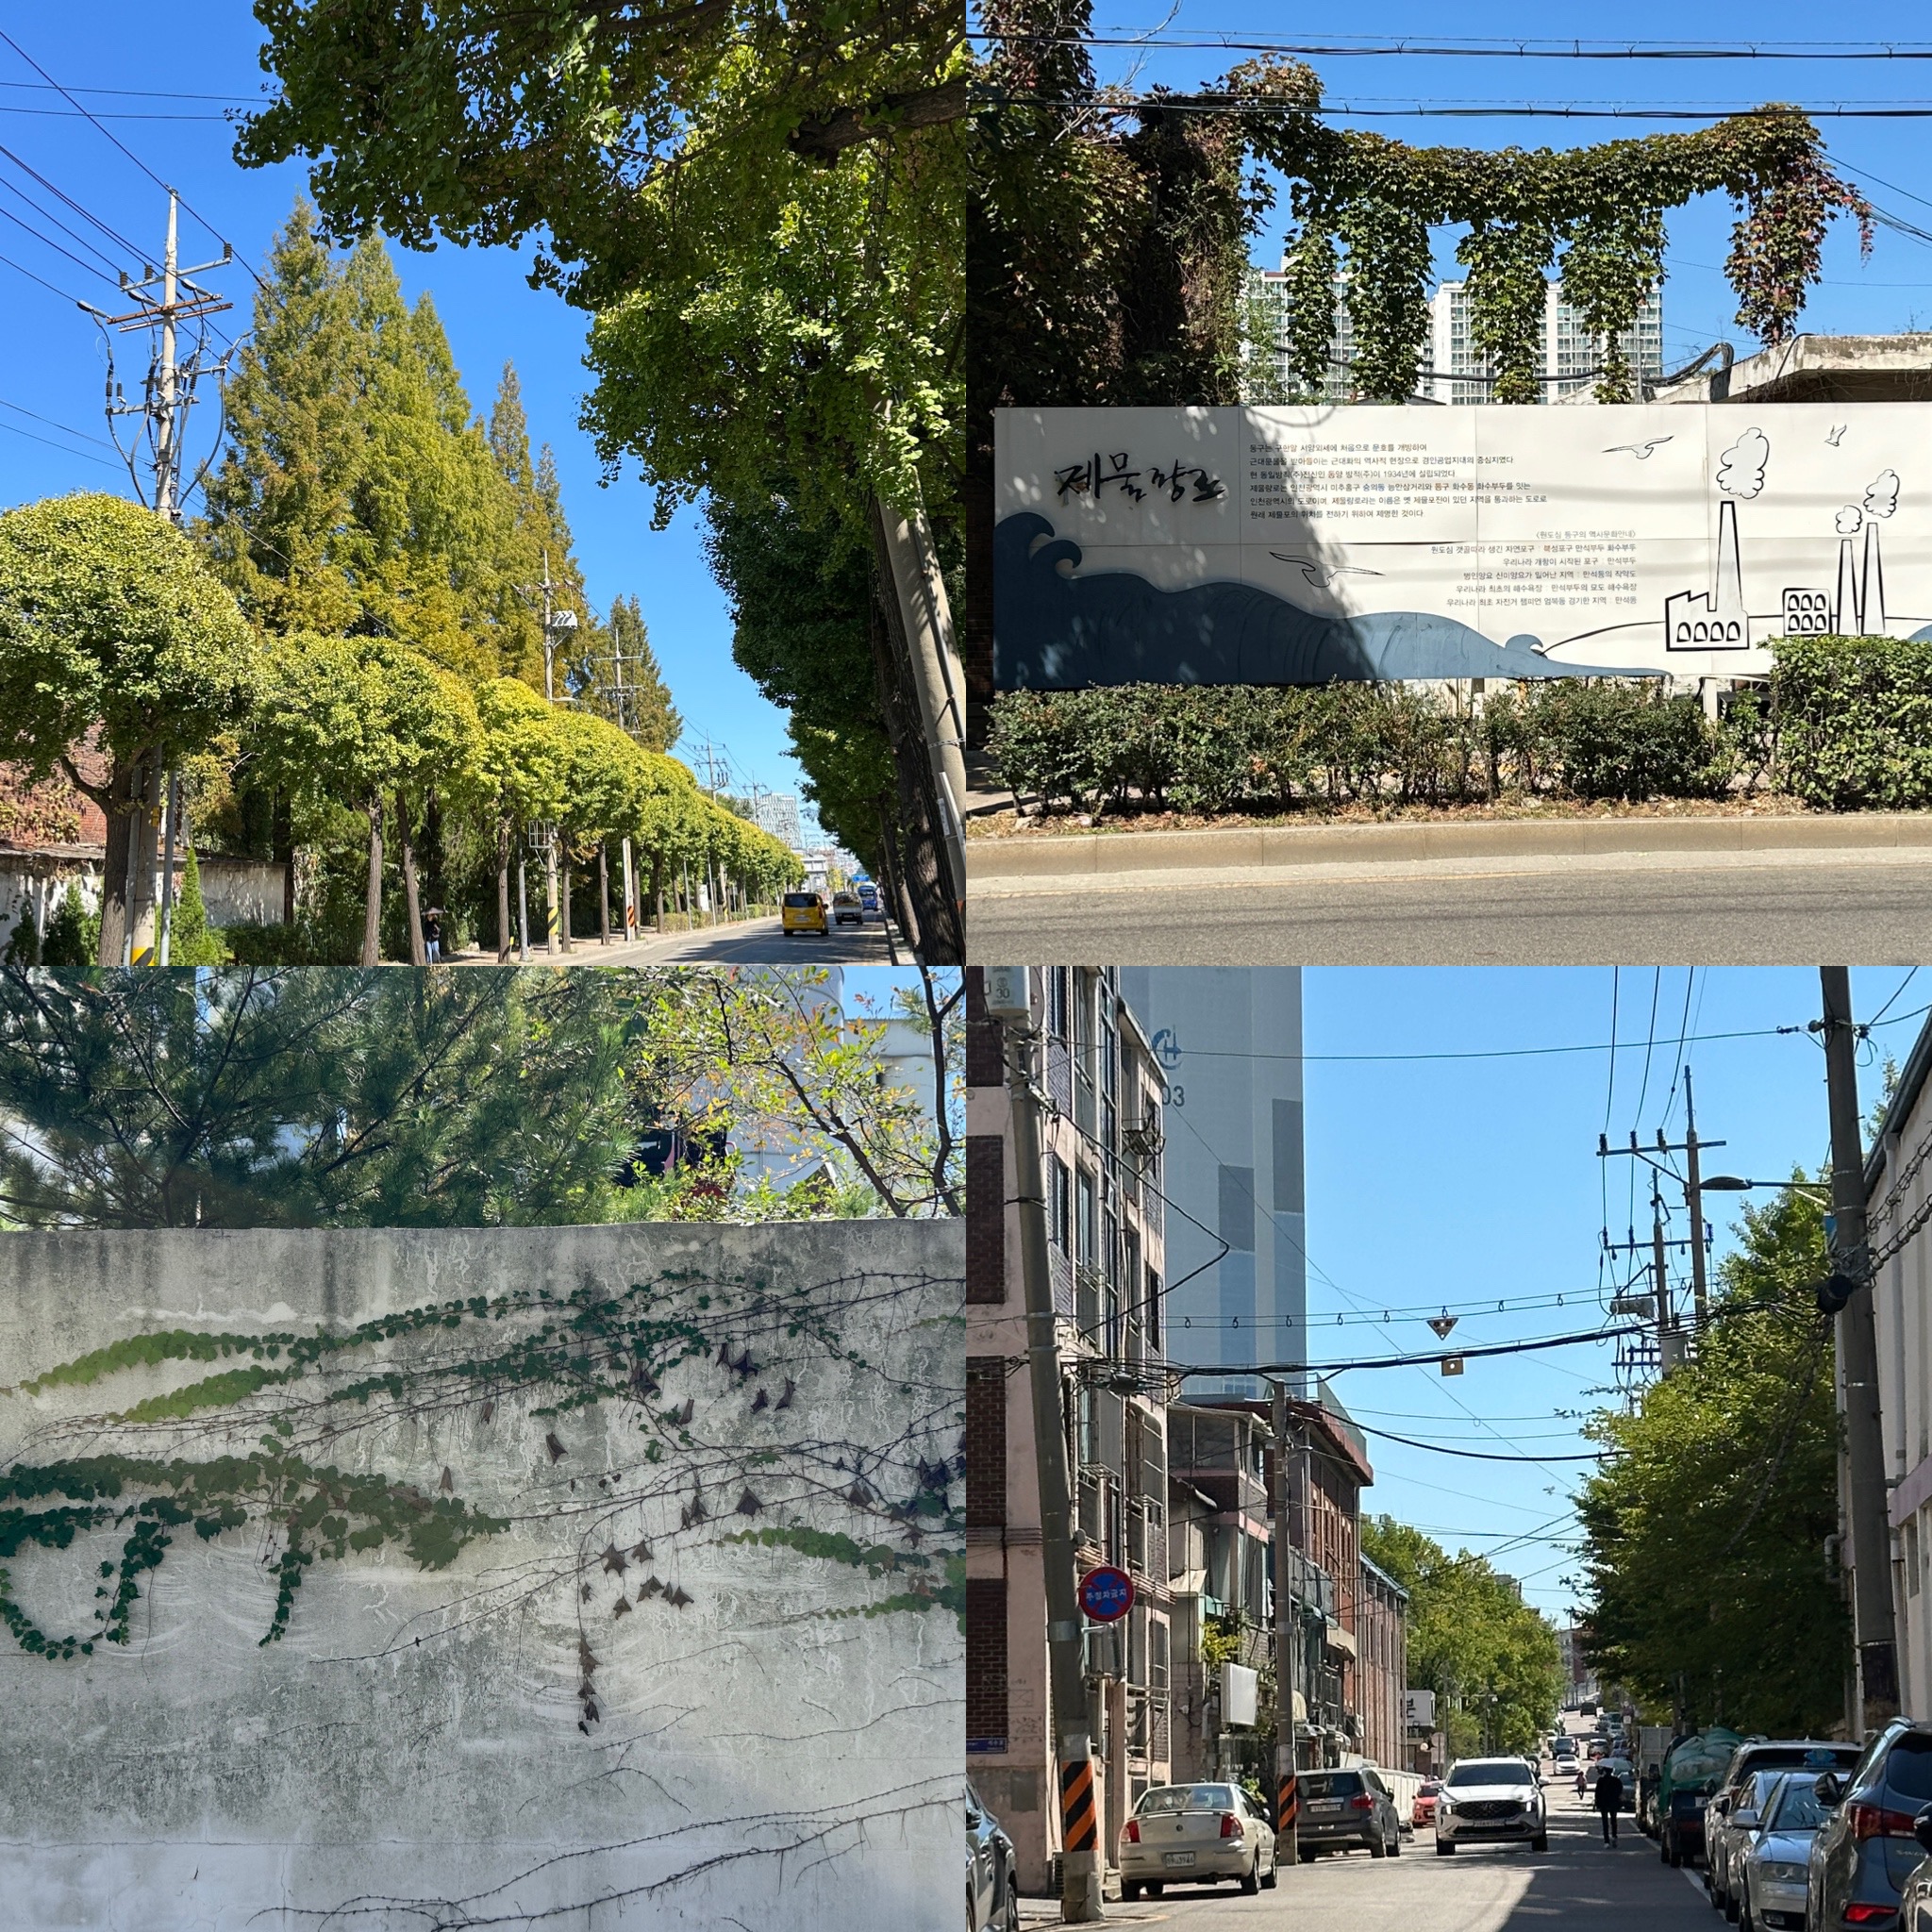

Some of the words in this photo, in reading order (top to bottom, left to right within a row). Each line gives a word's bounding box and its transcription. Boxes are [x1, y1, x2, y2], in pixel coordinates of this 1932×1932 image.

[1250, 444, 1273, 453] 동구는
[1341, 444, 1370, 453] 처음으로
[1373, 444, 1394, 453] 문호를
[1397, 444, 1427, 453] 개방하여
[1291, 458, 1329, 466] 받아들이는
[1364, 457, 1387, 465] 역사적
[1390, 457, 1420, 465] 현장으로
[1250, 471, 1257, 479] 현
[1328, 471, 1343, 479] 동양
[1384, 470, 1416, 478] 1934년에
[1290, 484, 1328, 492] 인천광역시
[1330, 483, 1360, 491] 미추홀구
[1363, 483, 1386, 491] 숭의동
[1388, 483, 1432, 491] 능안삼거리와
[1435, 483, 1450, 491] 동구
[1452, 482, 1474, 491] 화수동
[1476, 482, 1513, 491] 화수부두를
[1515, 482, 1532, 491] 잇는
[1250, 497, 1295, 506] 인천광역시의
[1378, 496, 1401, 505] 이름은
[1470, 495, 1491, 504] 지역을
[1250, 510, 1266, 519] 원래
[1268, 510, 1298, 519] 제물포의
[1301, 510, 1324, 519] 위치를
[1564, 530, 1587, 539] 동구의
[1431, 546, 1454, 555] 원도심
[1489, 545, 1504, 554] 생긴
[1505, 545, 1535, 554] 자연포구
[1543, 544, 1574, 553] 북성포구
[1574, 544, 1605, 553] 만석부두
[1607, 543, 1637, 552] 화수부두
[1503, 558, 1532, 567] 우리나라
[1534, 558, 1557, 566] 개항이
[1558, 558, 1581, 566] 시작된
[1583, 557, 1599, 565] 포구
[1607, 557, 1637, 565] 만석부두
[1463, 572, 1493, 580] 병인양요
[1495, 572, 1533, 580] 신미양요가
[1534, 571, 1557, 579] 일어난
[1558, 571, 1574, 579] 지역
[1582, 570, 1612, 578] 만석동의
[1614, 570, 1638, 578] 작약도
[1456, 585, 1486, 593] 우리나라
[1488, 585, 1511, 593] 최초의
[1512, 584, 1542, 592] 해수욕장
[1551, 584, 1589, 592] 만석부두의
[1607, 583, 1638, 591] 해수욕장
[1446, 598, 1476, 607] 우리나라
[1478, 598, 1493, 607] 최초
[1495, 597, 1519, 606] 자전거
[1520, 597, 1542, 606] 챔피언
[1543, 597, 1566, 606] 엄복동
[1568, 597, 1591, 606] 경기한
[1591, 596, 1607, 605] 지역
[1614, 596, 1638, 605] 만석동
[995, 988, 1010, 999] 30
[1086, 1589, 1127, 1602] 주정차금지
